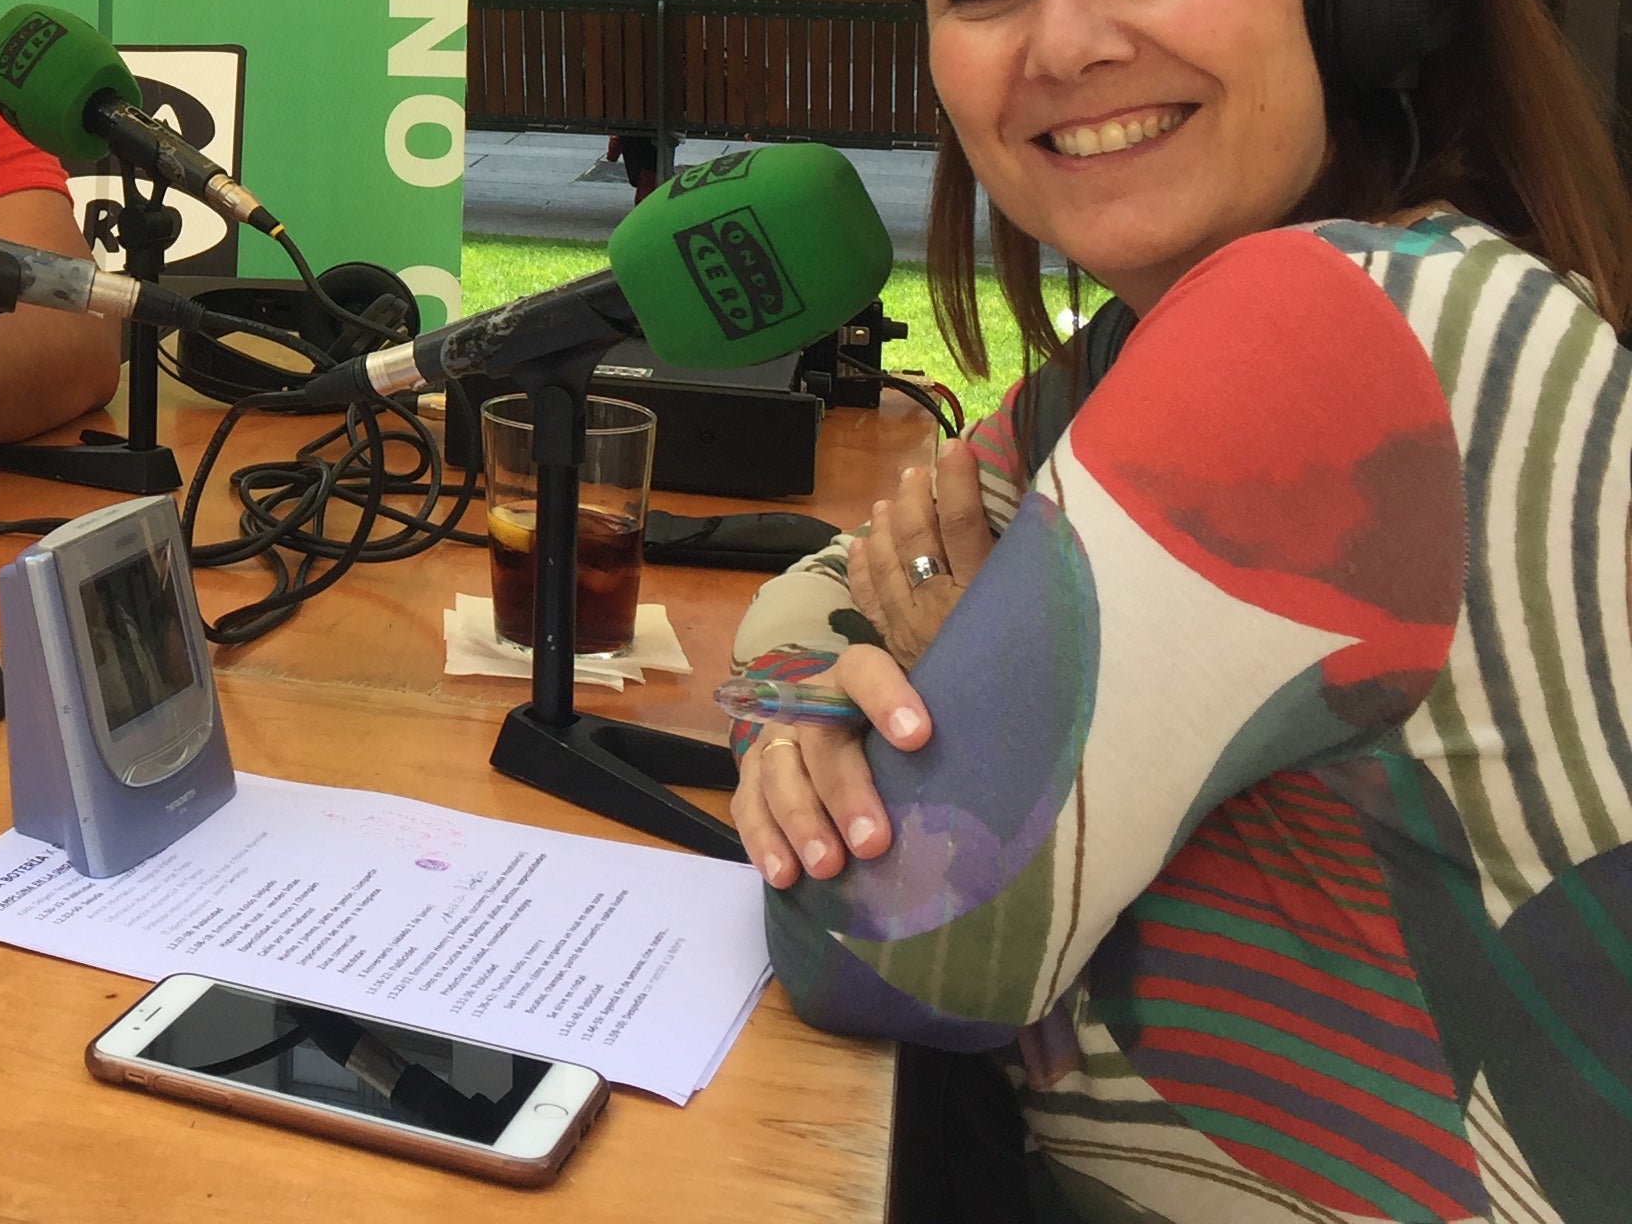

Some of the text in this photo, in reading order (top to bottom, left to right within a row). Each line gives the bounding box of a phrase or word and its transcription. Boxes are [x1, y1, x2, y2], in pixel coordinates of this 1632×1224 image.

[1, 18, 50, 64] ONDA
[14, 28, 52, 71] CERO
[697, 246, 748, 320] CERO
[727, 228, 775, 303] ONDA
